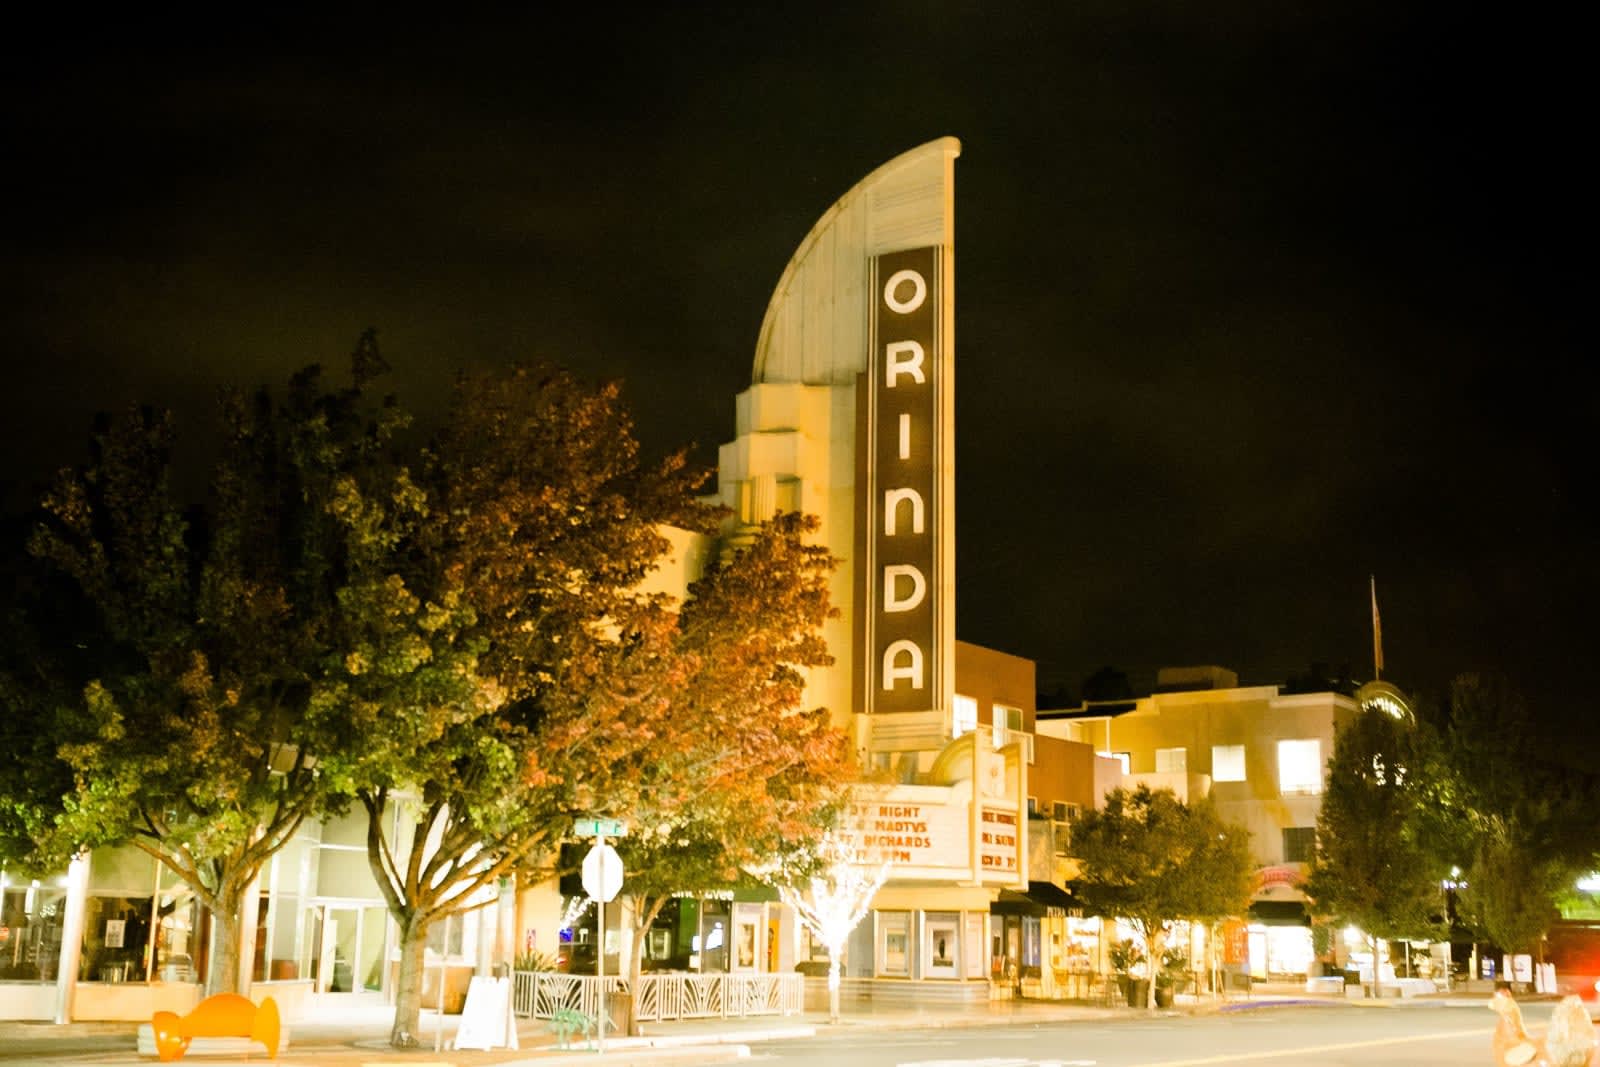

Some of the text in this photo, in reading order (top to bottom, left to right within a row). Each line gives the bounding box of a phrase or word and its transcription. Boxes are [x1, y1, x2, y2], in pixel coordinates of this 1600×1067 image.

[883, 269, 927, 691] ORINDA
[879, 806, 920, 818] NIGHT
[863, 834, 932, 849] RICHARDS
